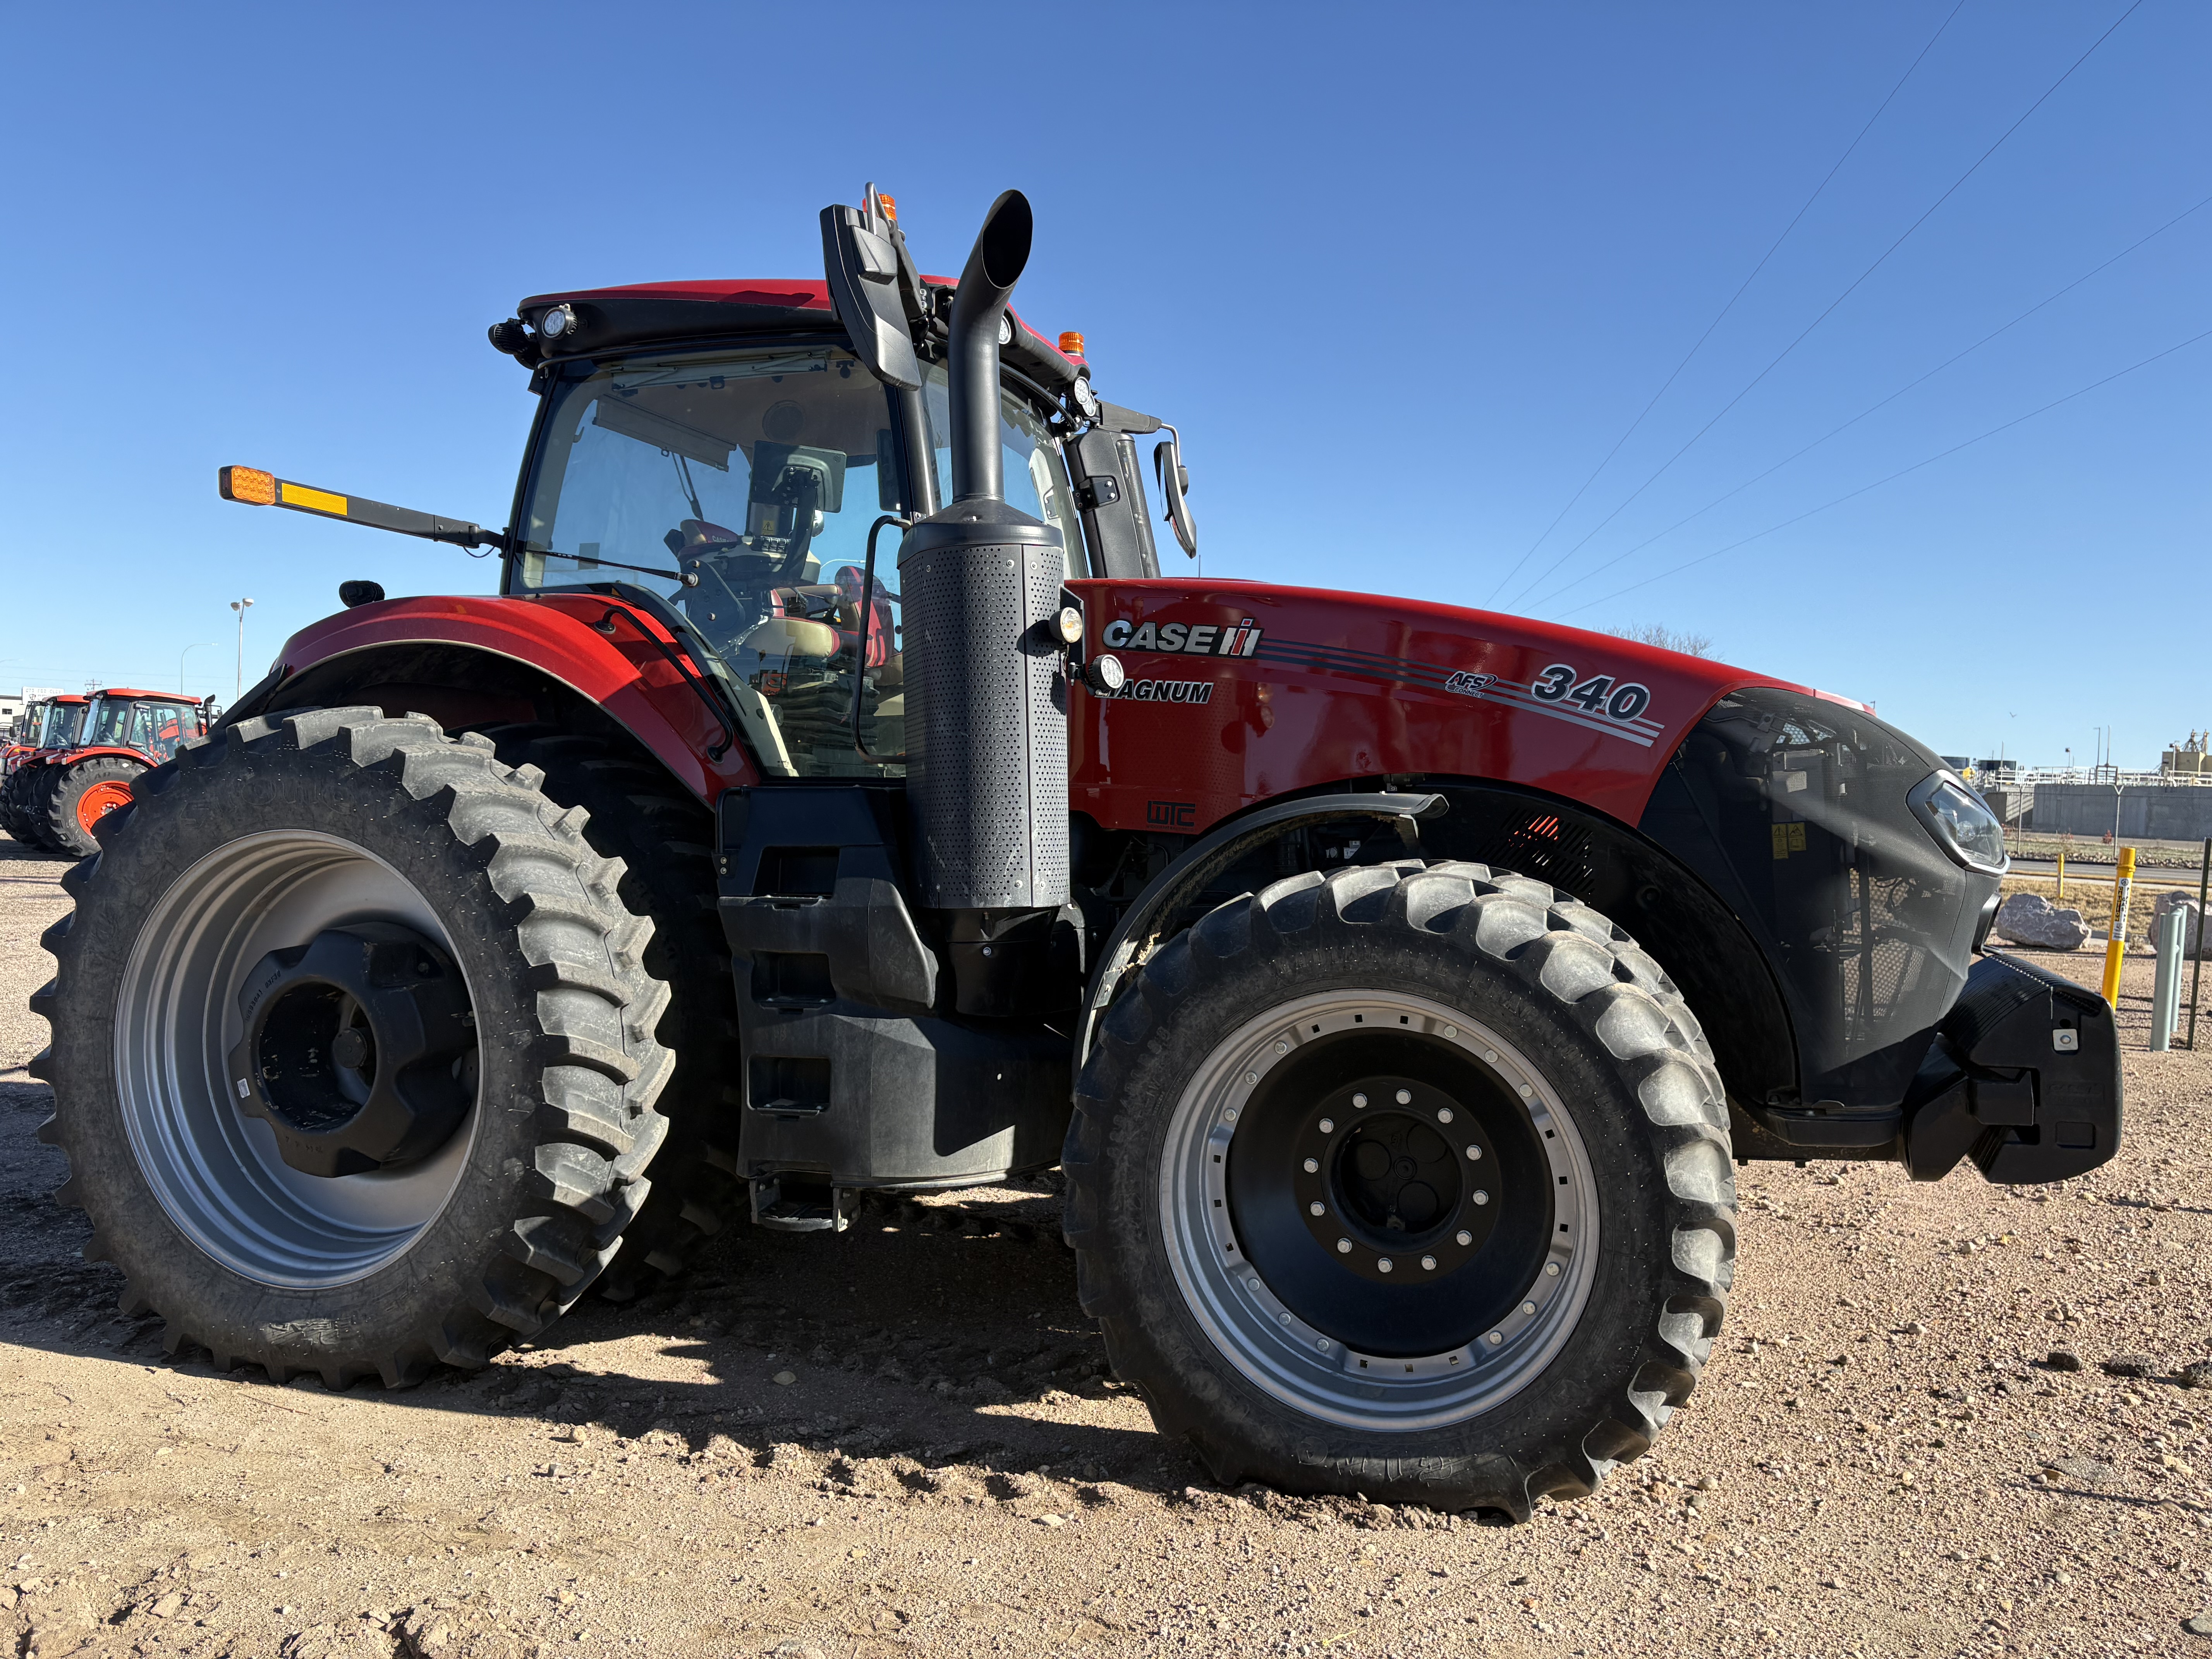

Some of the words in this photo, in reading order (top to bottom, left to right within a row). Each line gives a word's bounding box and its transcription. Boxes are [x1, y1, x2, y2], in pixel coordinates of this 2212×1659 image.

[1103, 620, 1219, 654] CASE
[1094, 678, 1214, 704] AGNUM
[1446, 672, 1486, 689] AFS
[1455, 687, 1484, 698] CONNECT
[1531, 663, 1650, 722] 340
[1147, 800, 1196, 826] WTC
